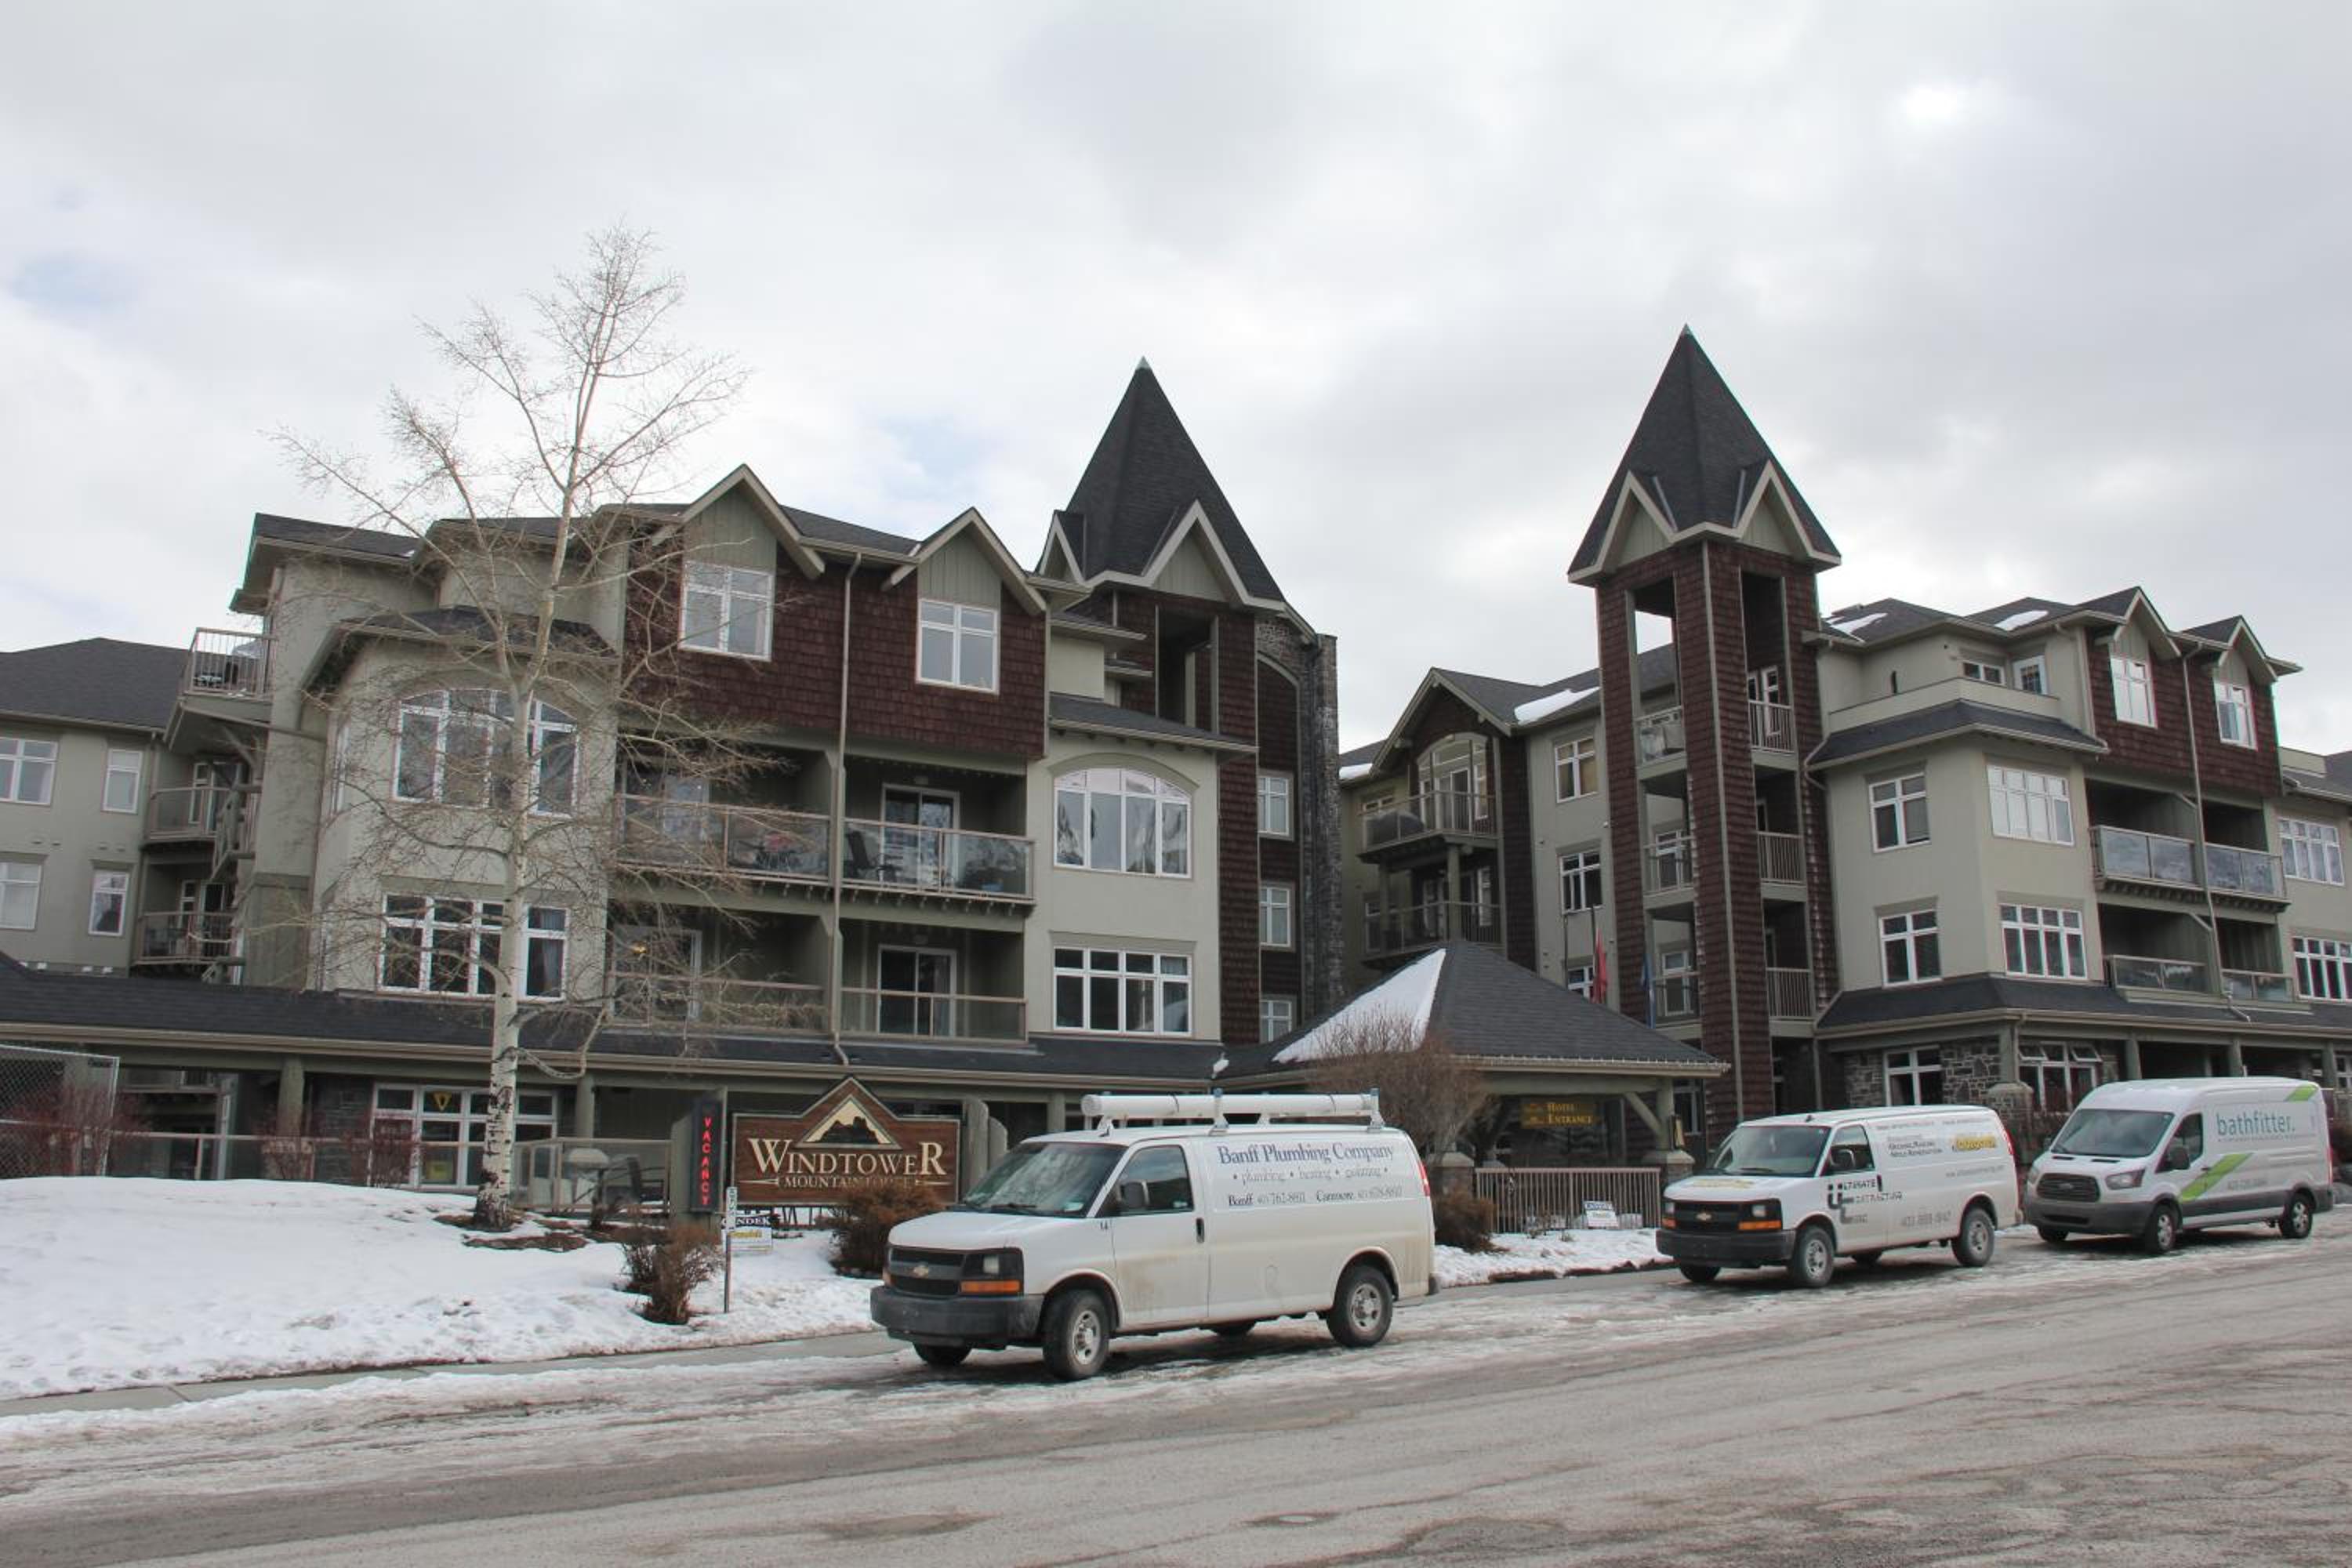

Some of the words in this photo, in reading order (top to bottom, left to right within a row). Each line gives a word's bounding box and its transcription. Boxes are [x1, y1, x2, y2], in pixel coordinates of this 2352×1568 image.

[702, 1117, 713, 1205] VACANCY
[748, 1138, 947, 1176] WINDTOWER
[1217, 1145, 1258, 1164] Banff
[1261, 1144, 1332, 1163] Plumbing
[1333, 1142, 1393, 1162] Company
[784, 1175, 861, 1189] MOUNTAIN
